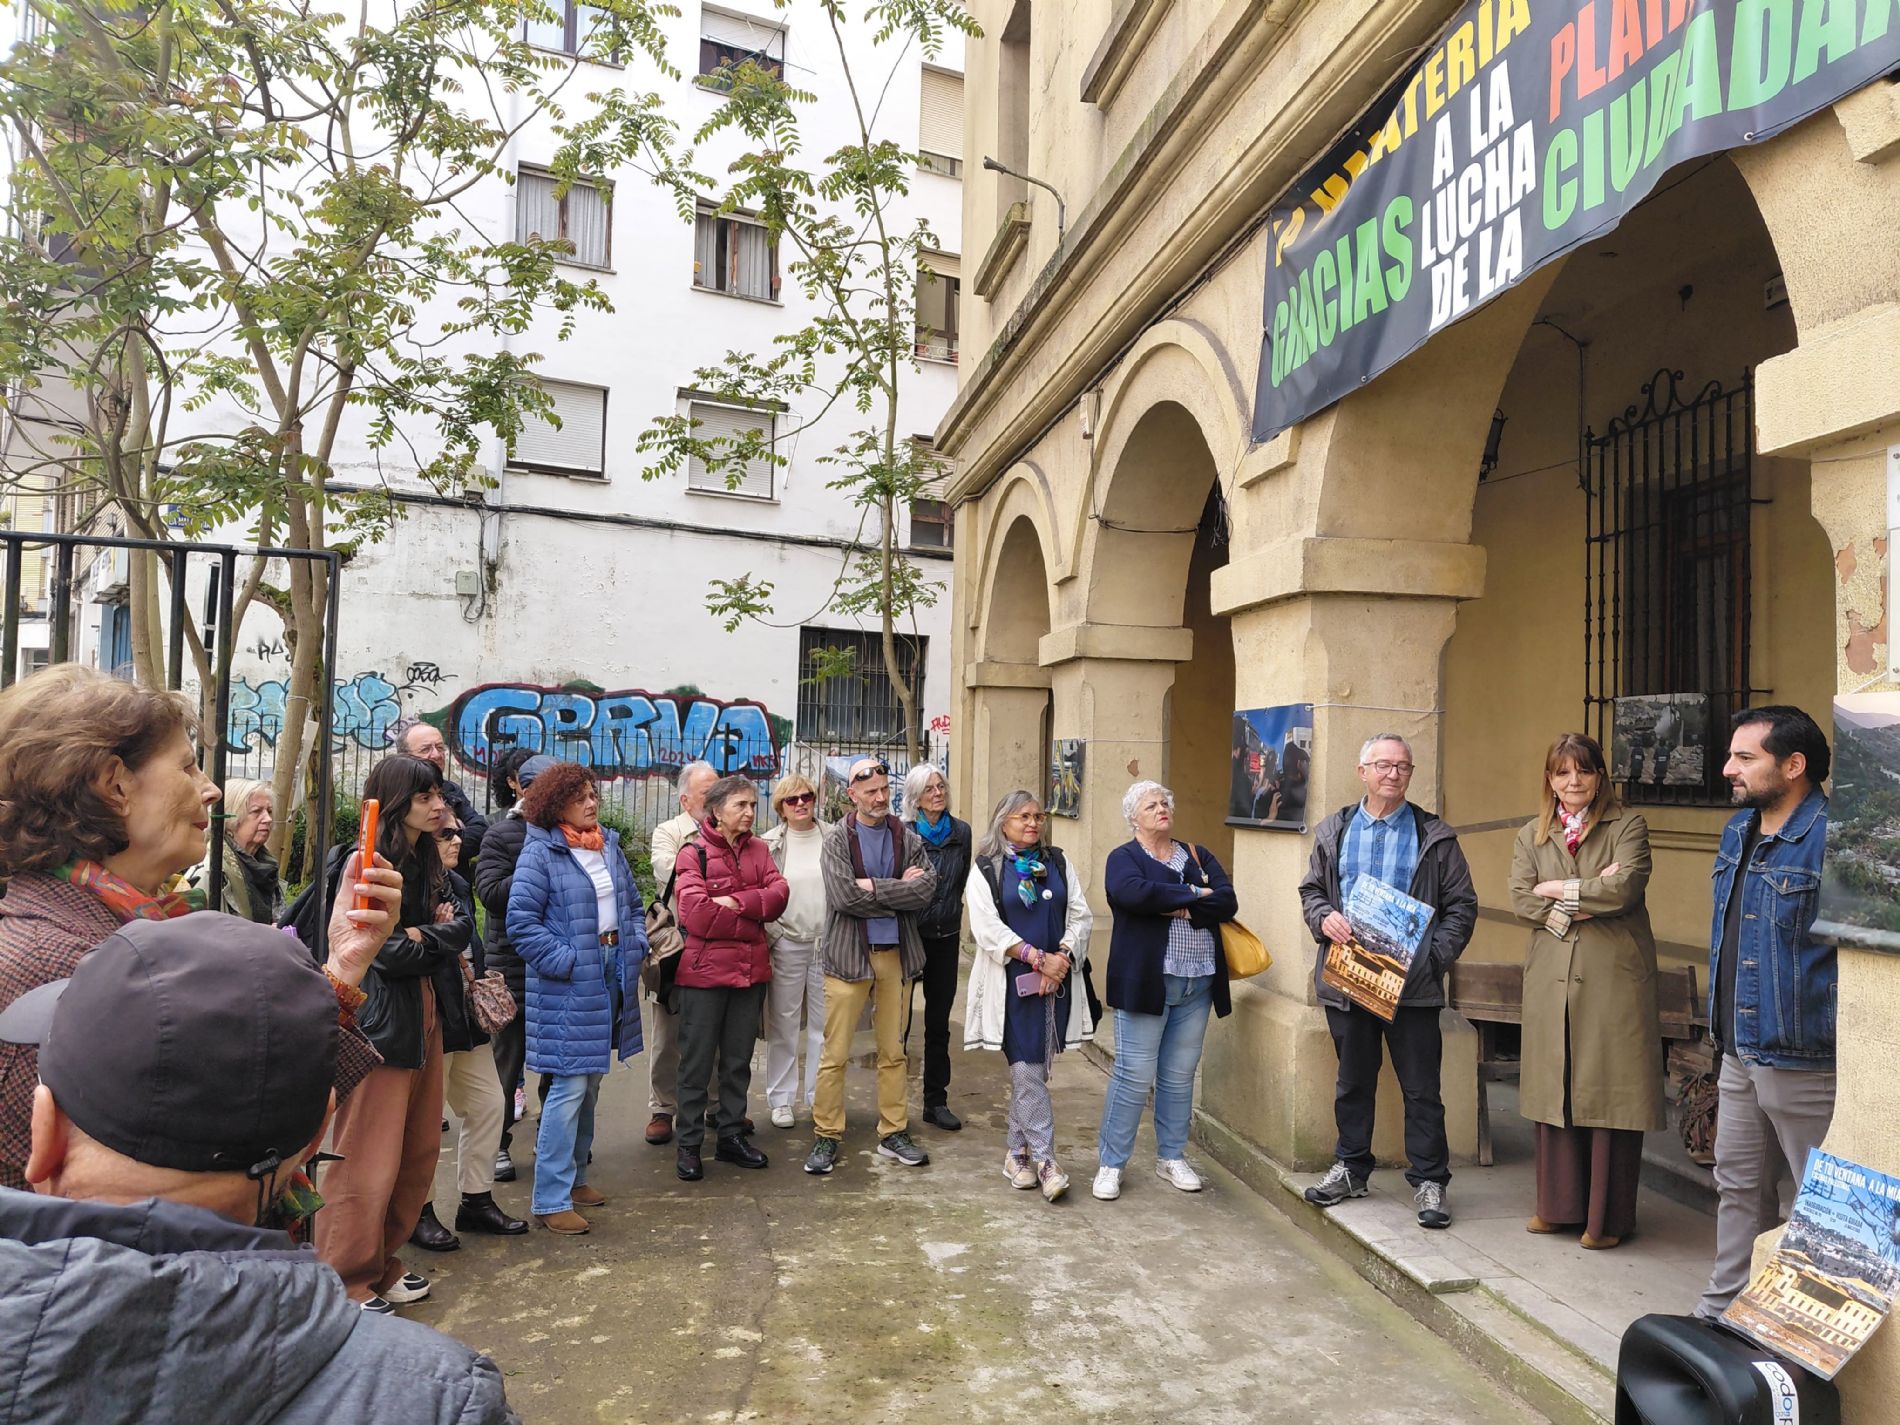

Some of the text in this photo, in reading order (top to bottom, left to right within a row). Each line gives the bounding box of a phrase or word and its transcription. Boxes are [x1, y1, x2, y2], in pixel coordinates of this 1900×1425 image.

[1432, 59, 1514, 190] A LA
[1421, 120, 1536, 270] LUCHA
[1271, 196, 1414, 388] GRACIAS
[1428, 207, 1523, 331] DE LA
[1834, 1165, 1866, 1188] VENTANA
[1868, 1178, 1875, 1192] A
[1875, 1180, 1885, 1196] LA
